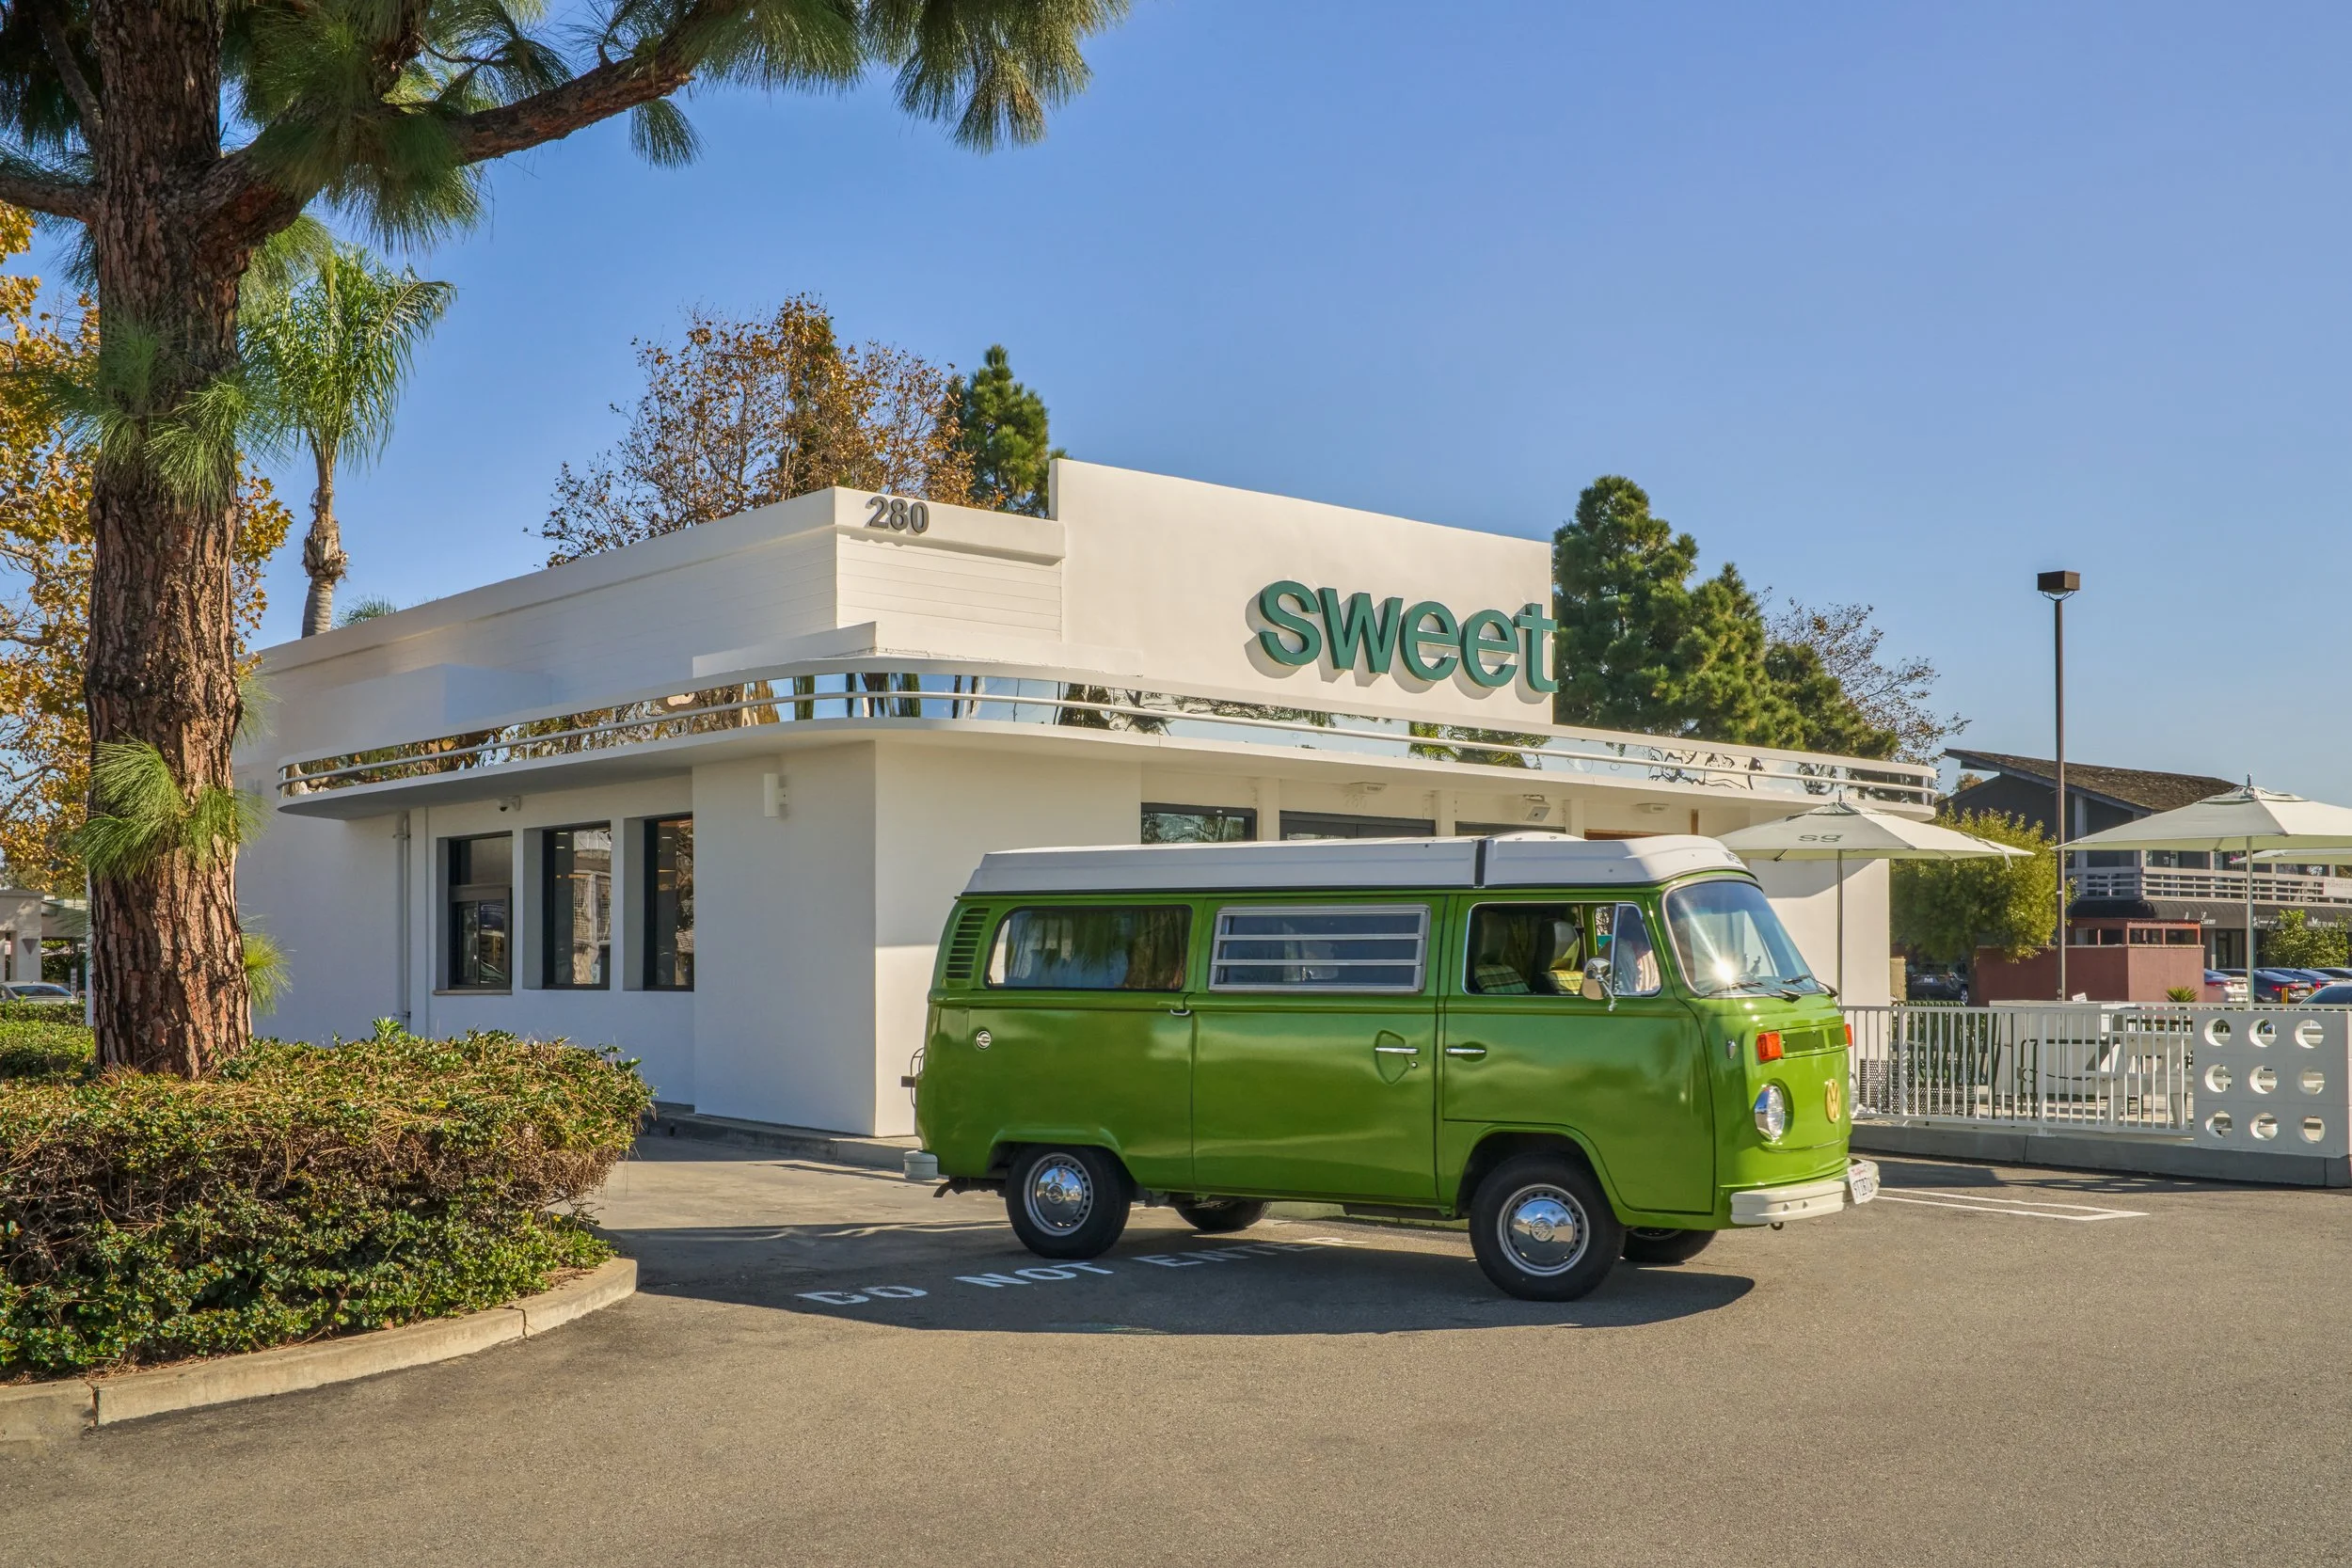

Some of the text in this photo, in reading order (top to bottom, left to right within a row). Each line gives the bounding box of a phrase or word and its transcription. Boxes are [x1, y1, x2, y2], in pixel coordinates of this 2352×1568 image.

[865, 495, 930, 534] 280
[1258, 579, 1559, 694] sweet
[1798, 833, 1844, 843] sg
[795, 1285, 929, 1306] DO
[953, 1261, 1114, 1288] NOT
